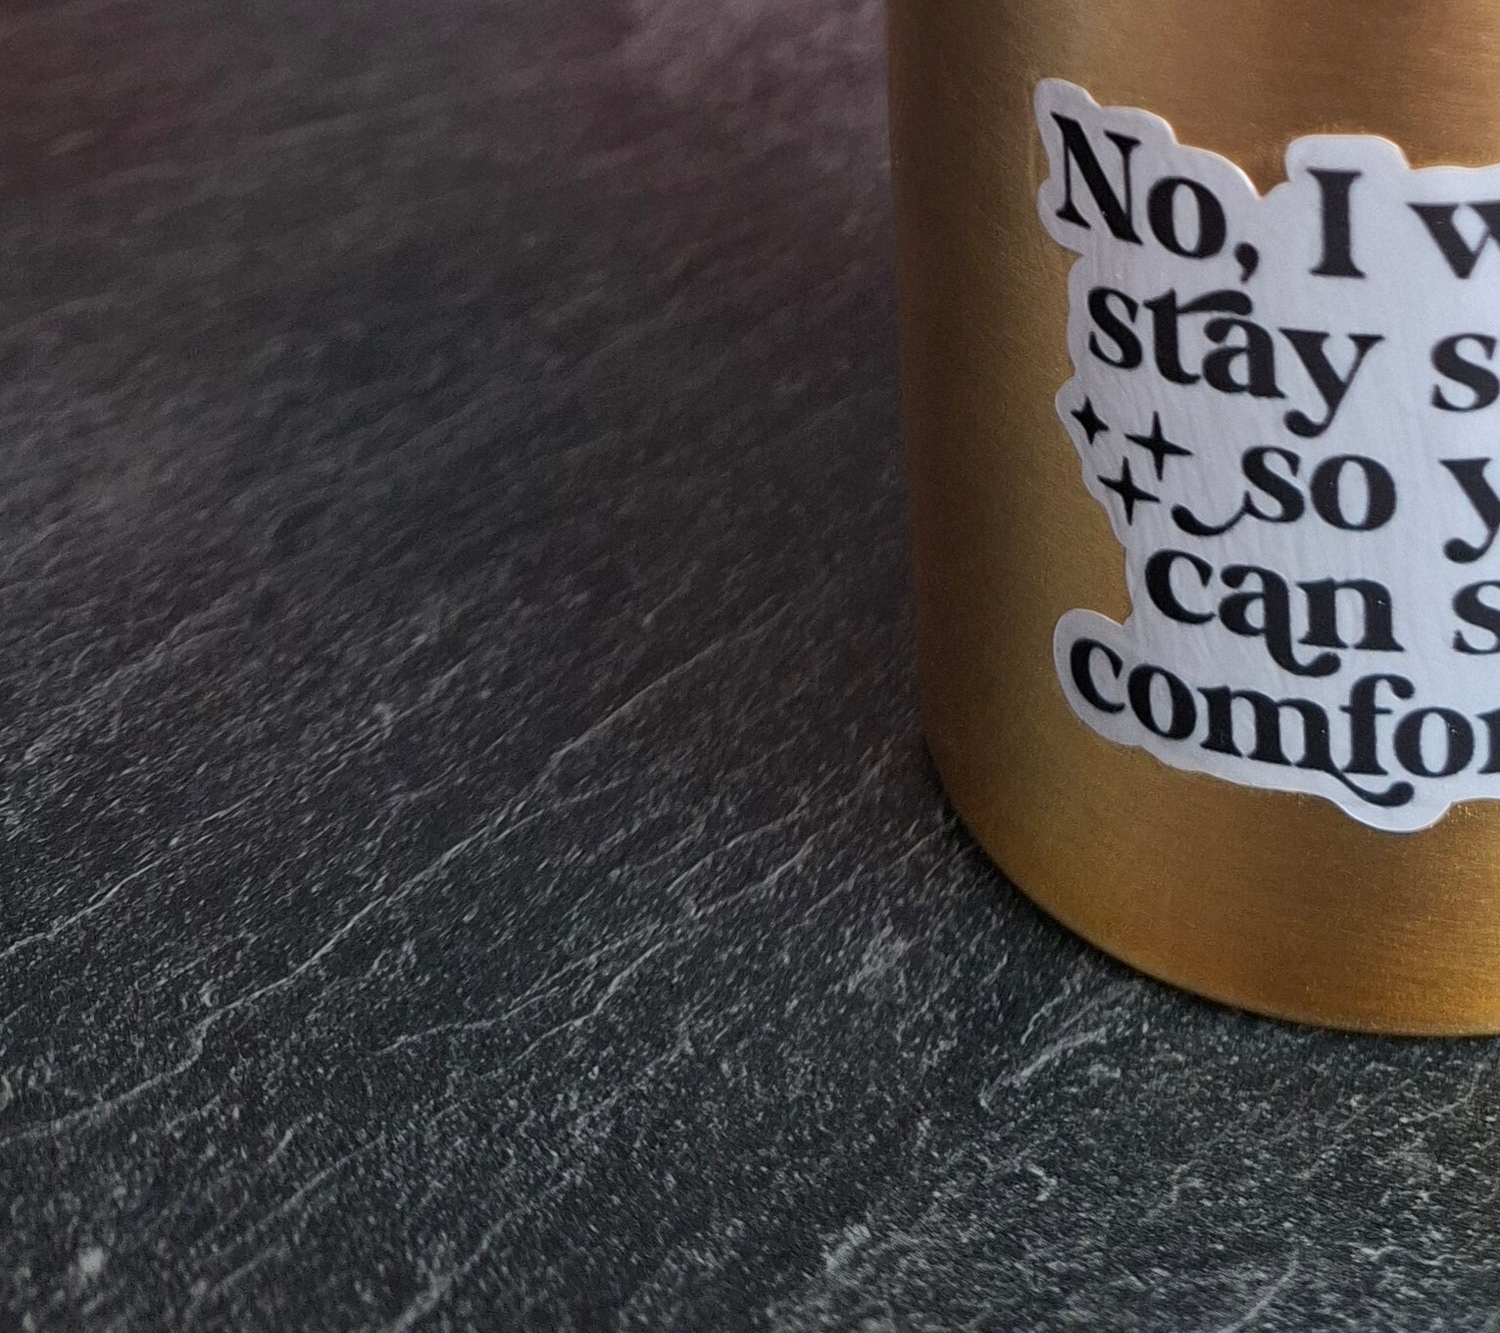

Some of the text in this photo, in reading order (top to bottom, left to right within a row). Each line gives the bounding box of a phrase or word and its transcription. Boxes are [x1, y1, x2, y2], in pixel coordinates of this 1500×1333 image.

[1049, 111, 1261, 284] No,
[1308, 168, 1365, 279] I
[1086, 285, 1386, 439] stay
[1171, 445, 1398, 538] so
[1143, 548, 1406, 679] can
